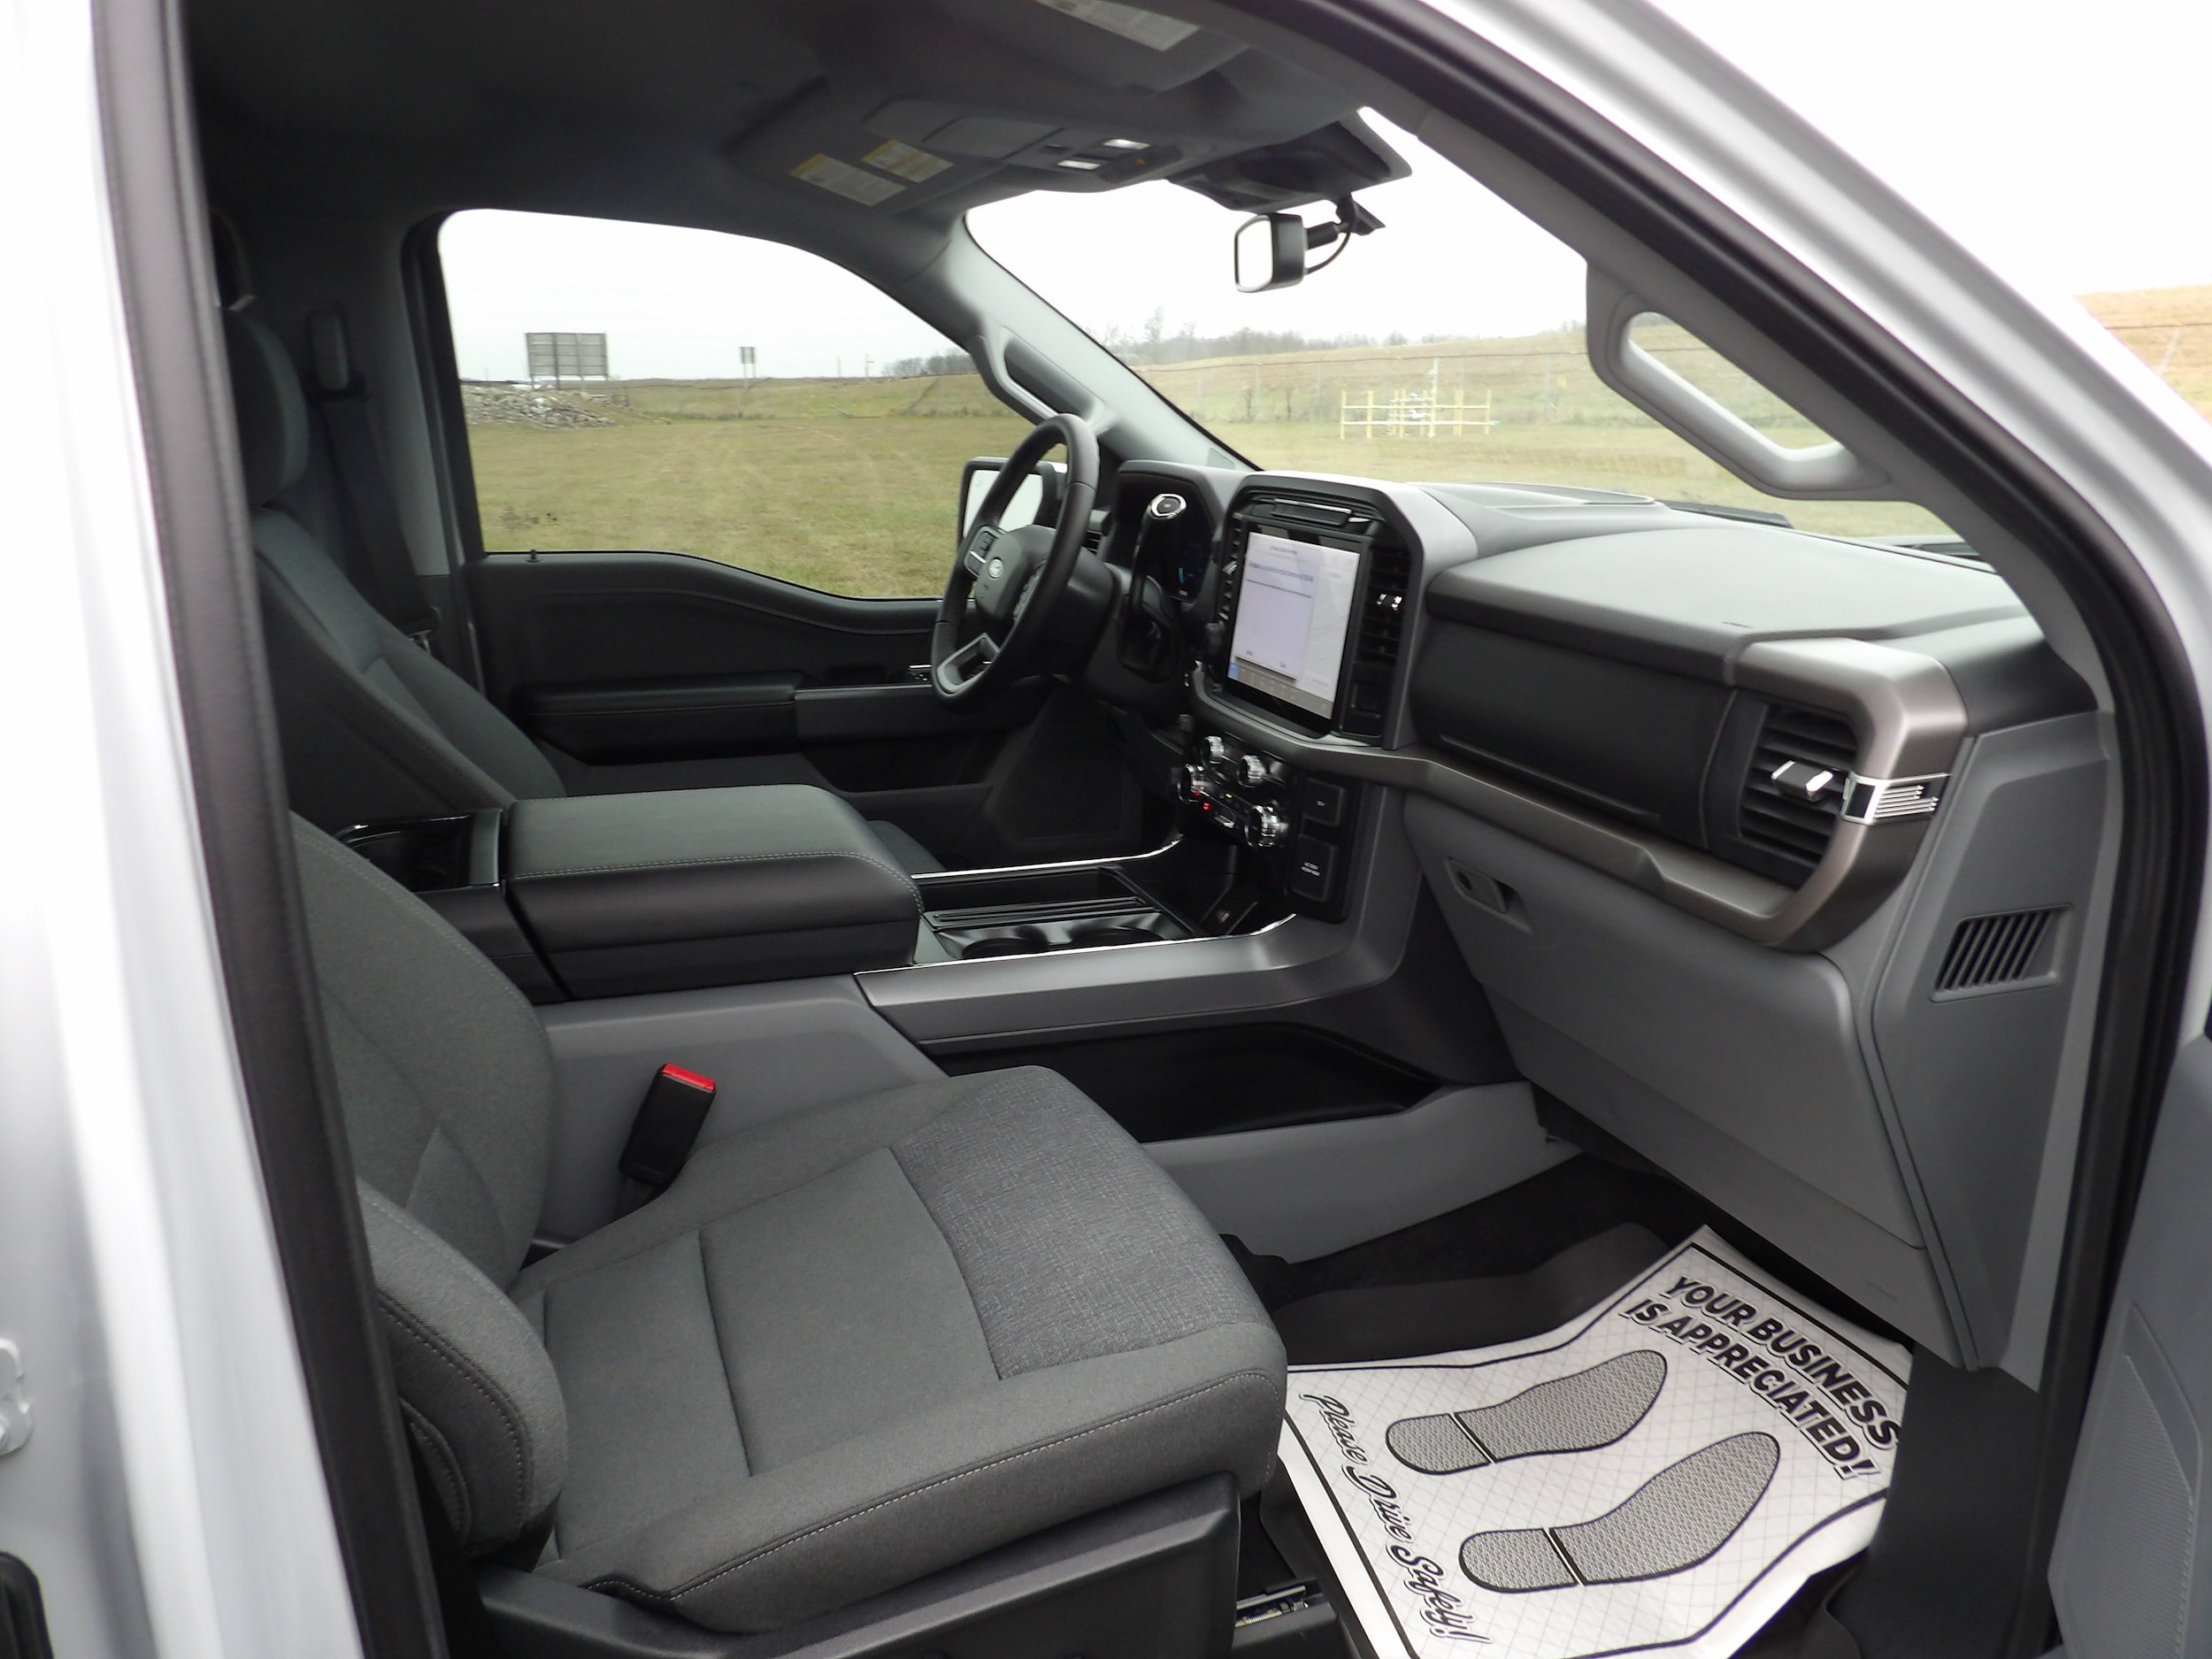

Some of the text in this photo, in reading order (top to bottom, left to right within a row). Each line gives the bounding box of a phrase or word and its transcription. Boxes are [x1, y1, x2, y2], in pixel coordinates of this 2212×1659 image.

[1621, 1299, 1880, 1478] IS APPRECIATED!
[1663, 1276, 1901, 1447] YOUR BUSINESS
[1300, 1394, 1493, 1643] Please Drive Safely!
